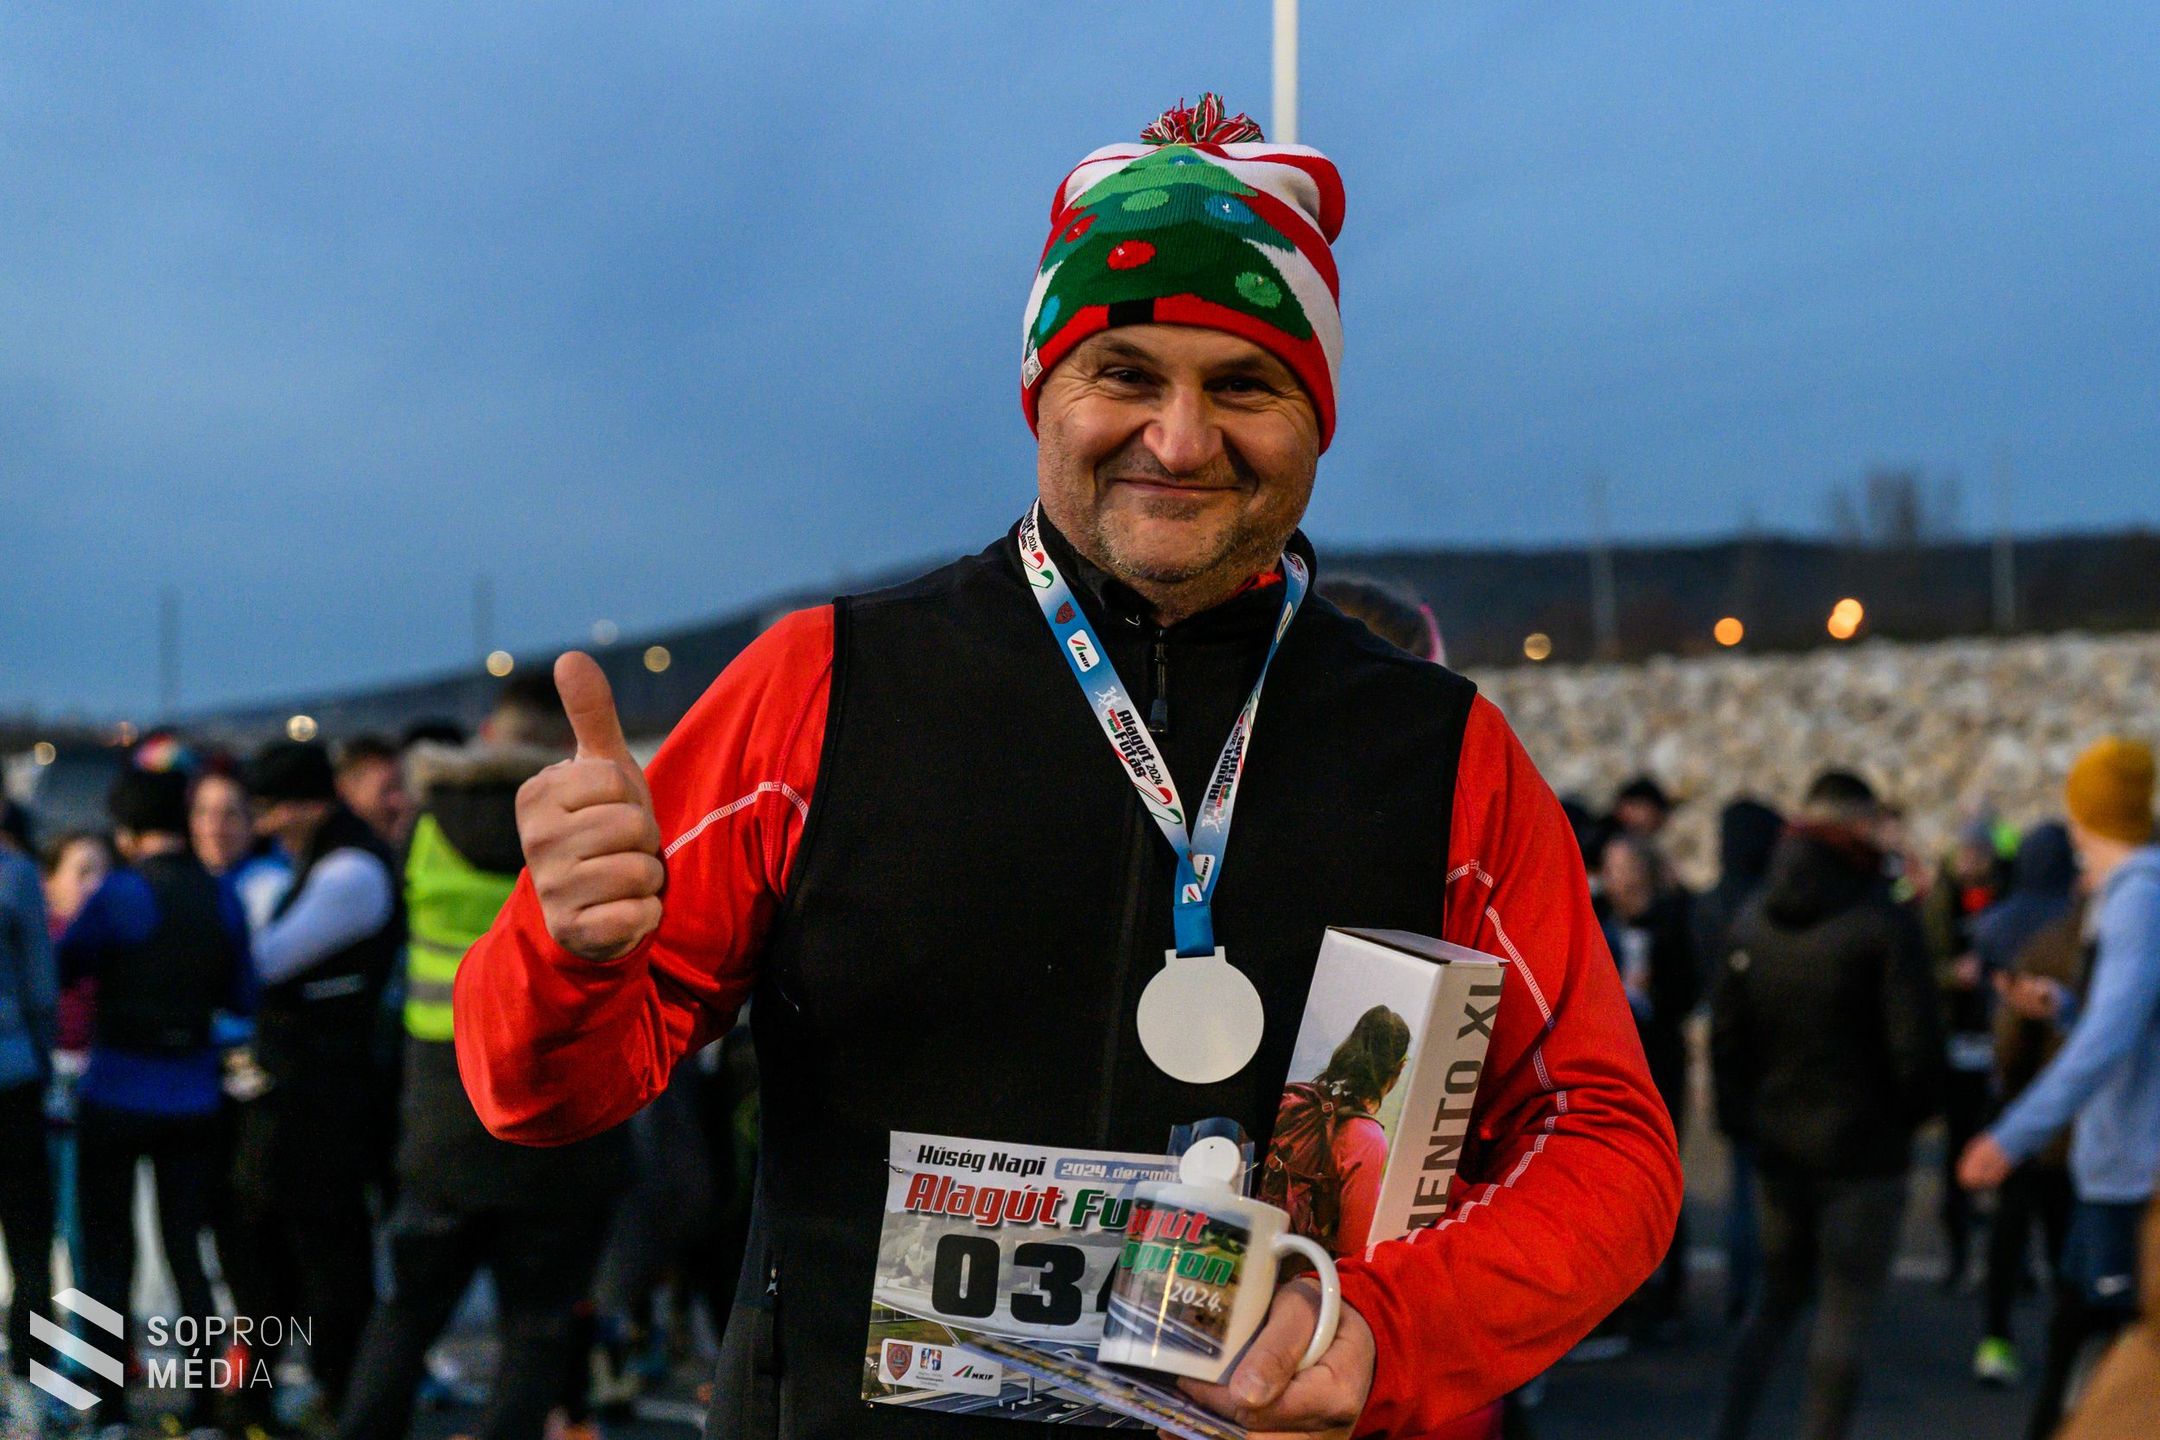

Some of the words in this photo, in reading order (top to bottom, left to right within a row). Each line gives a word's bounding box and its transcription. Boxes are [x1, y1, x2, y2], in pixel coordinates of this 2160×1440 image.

[1114, 731, 1147, 778] Futás
[1117, 709, 1155, 763] Alagút
[1145, 763, 1164, 785] 2024
[917, 1144, 986, 1173] Hűség
[988, 1152, 1048, 1178] Napi
[904, 1173, 1064, 1227] Alagút
[1168, 1282, 1222, 1313] 2024.
